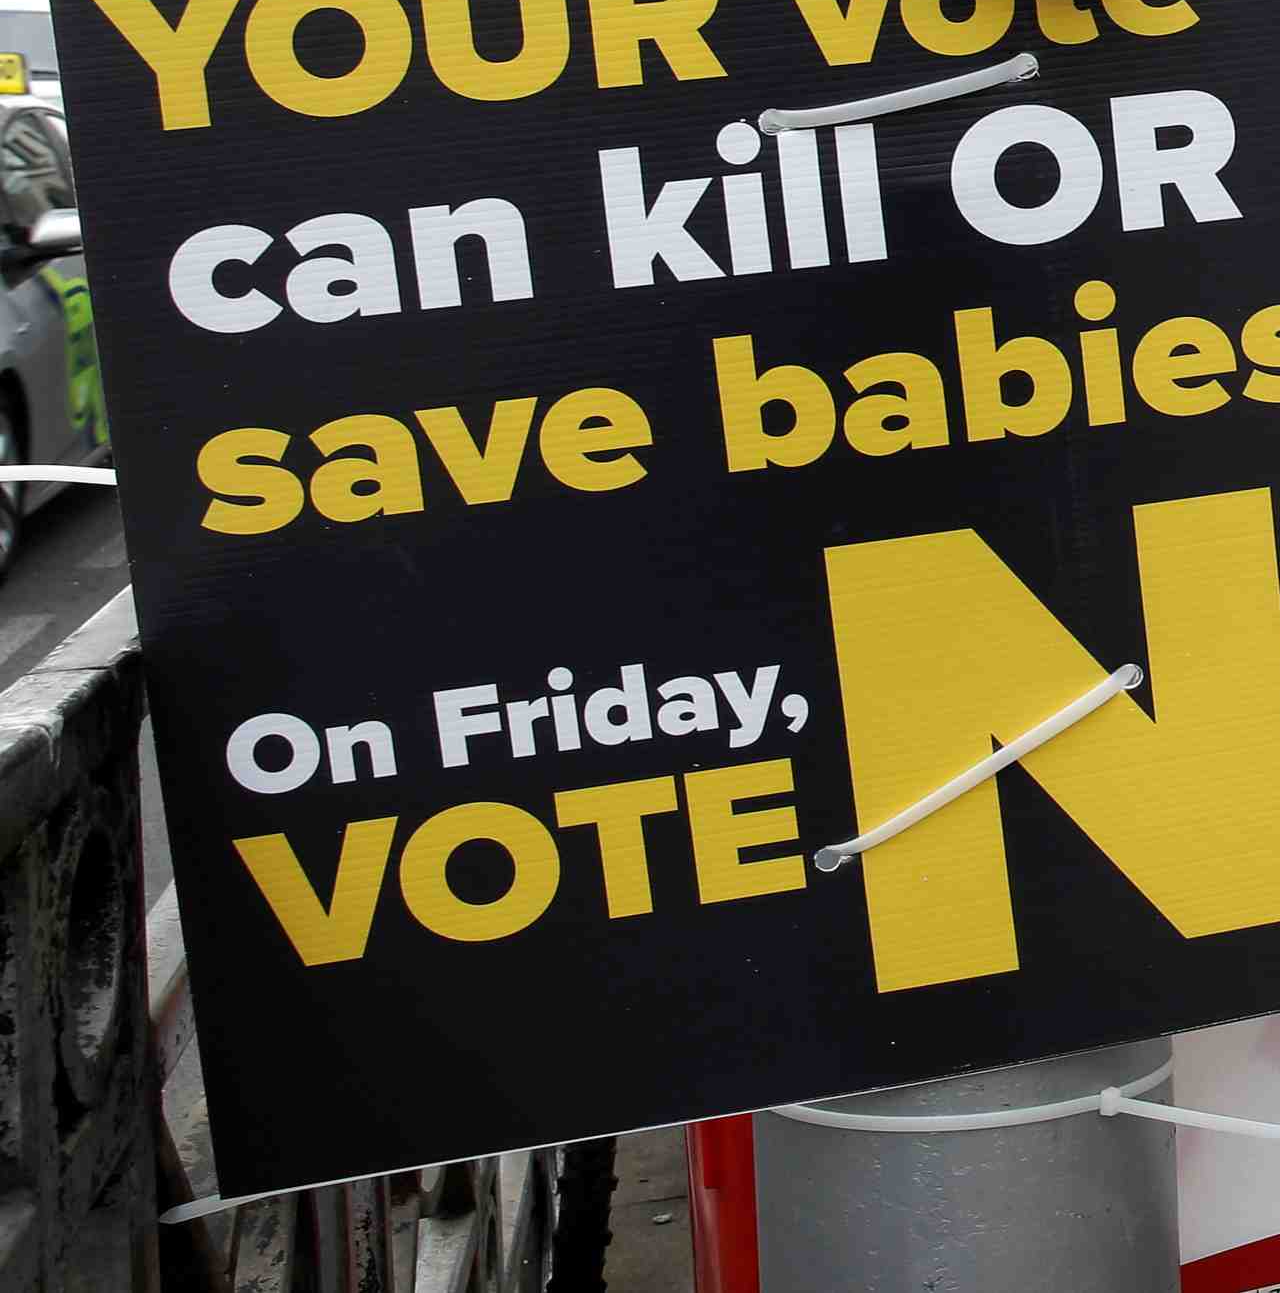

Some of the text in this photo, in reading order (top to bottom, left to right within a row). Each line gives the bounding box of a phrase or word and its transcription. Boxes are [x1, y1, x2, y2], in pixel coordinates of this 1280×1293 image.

[167, 89, 1244, 335] can kill OR
[196, 386, 653, 536] save
[225, 663, 809, 795] On Friday,
[233, 758, 806, 968] VOTE
